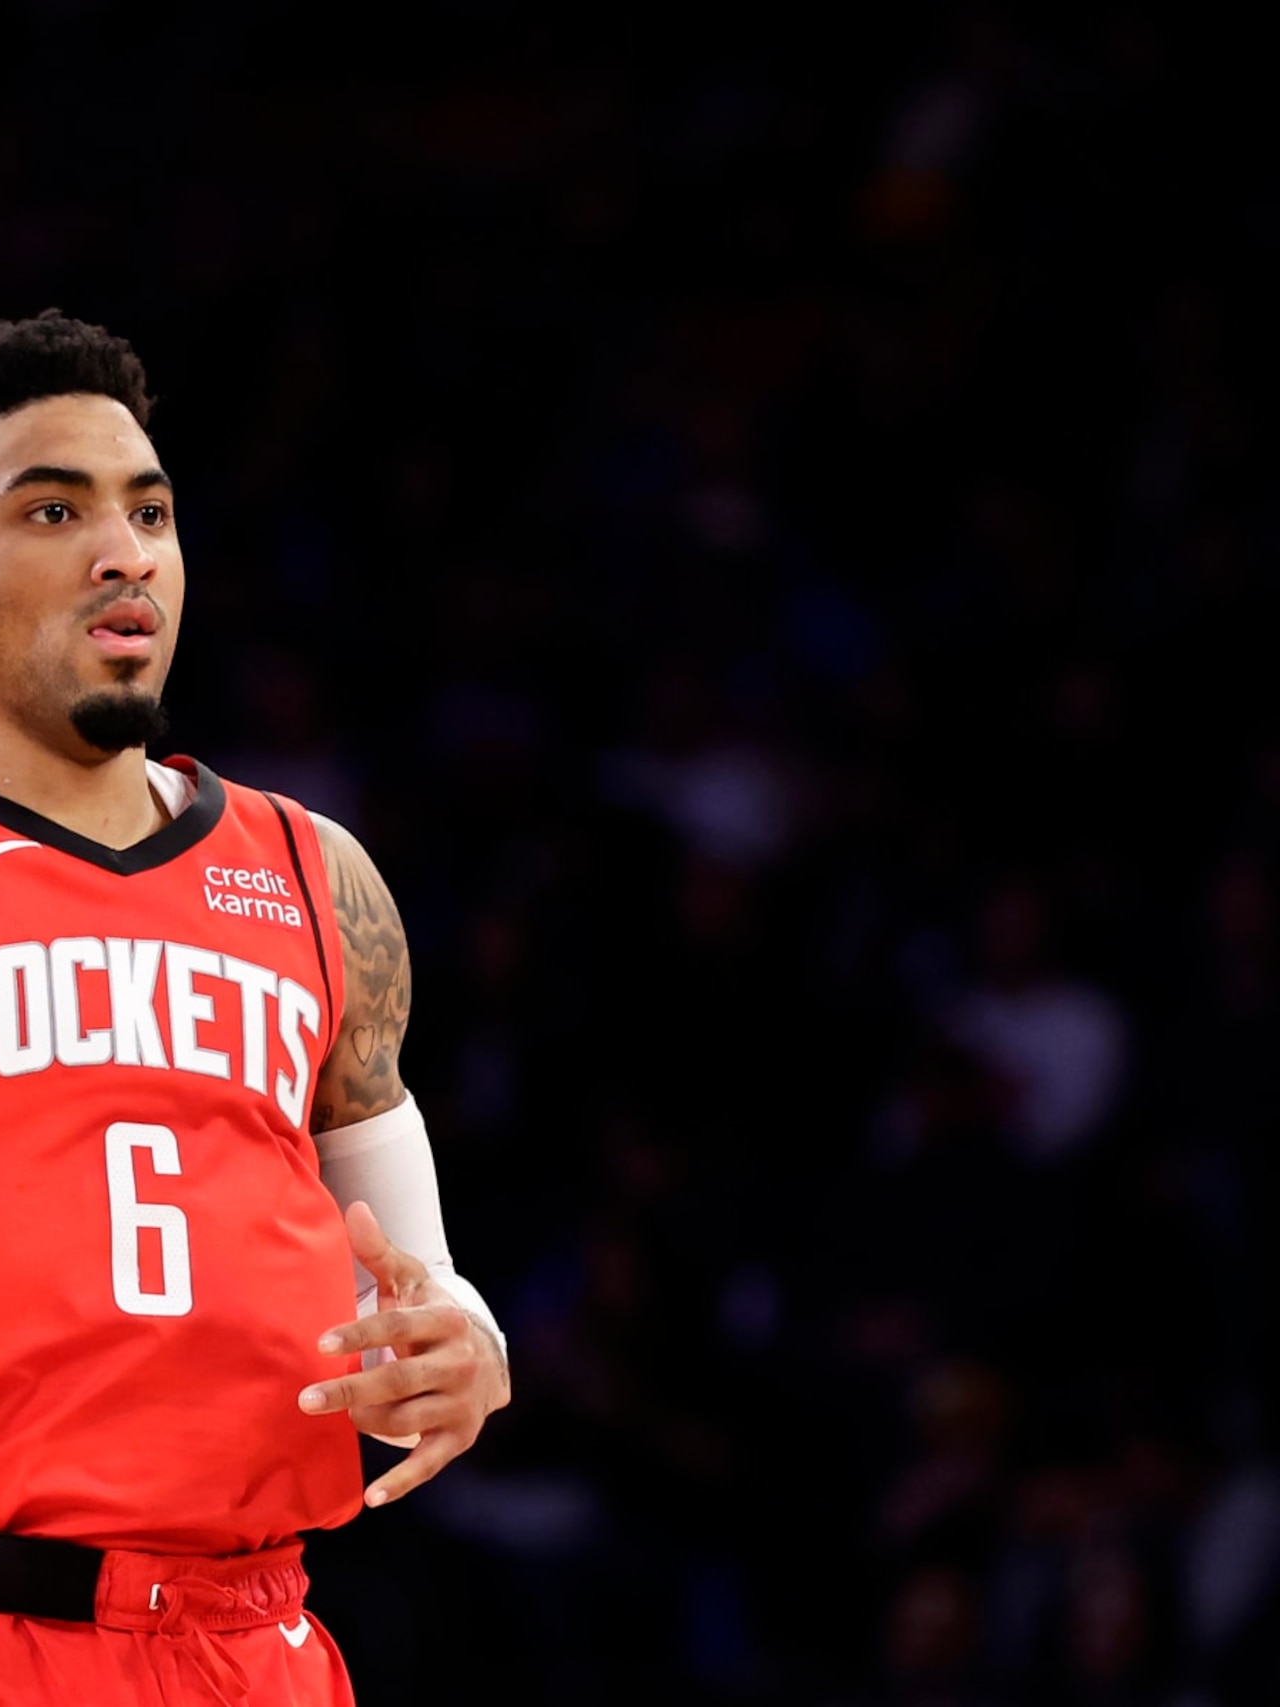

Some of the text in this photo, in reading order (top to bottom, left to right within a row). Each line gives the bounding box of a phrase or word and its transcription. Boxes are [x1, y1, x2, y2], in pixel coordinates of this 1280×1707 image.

[205, 866, 291, 897] credit
[204, 885, 302, 927] karma
[105, 1121, 194, 1316] 6
